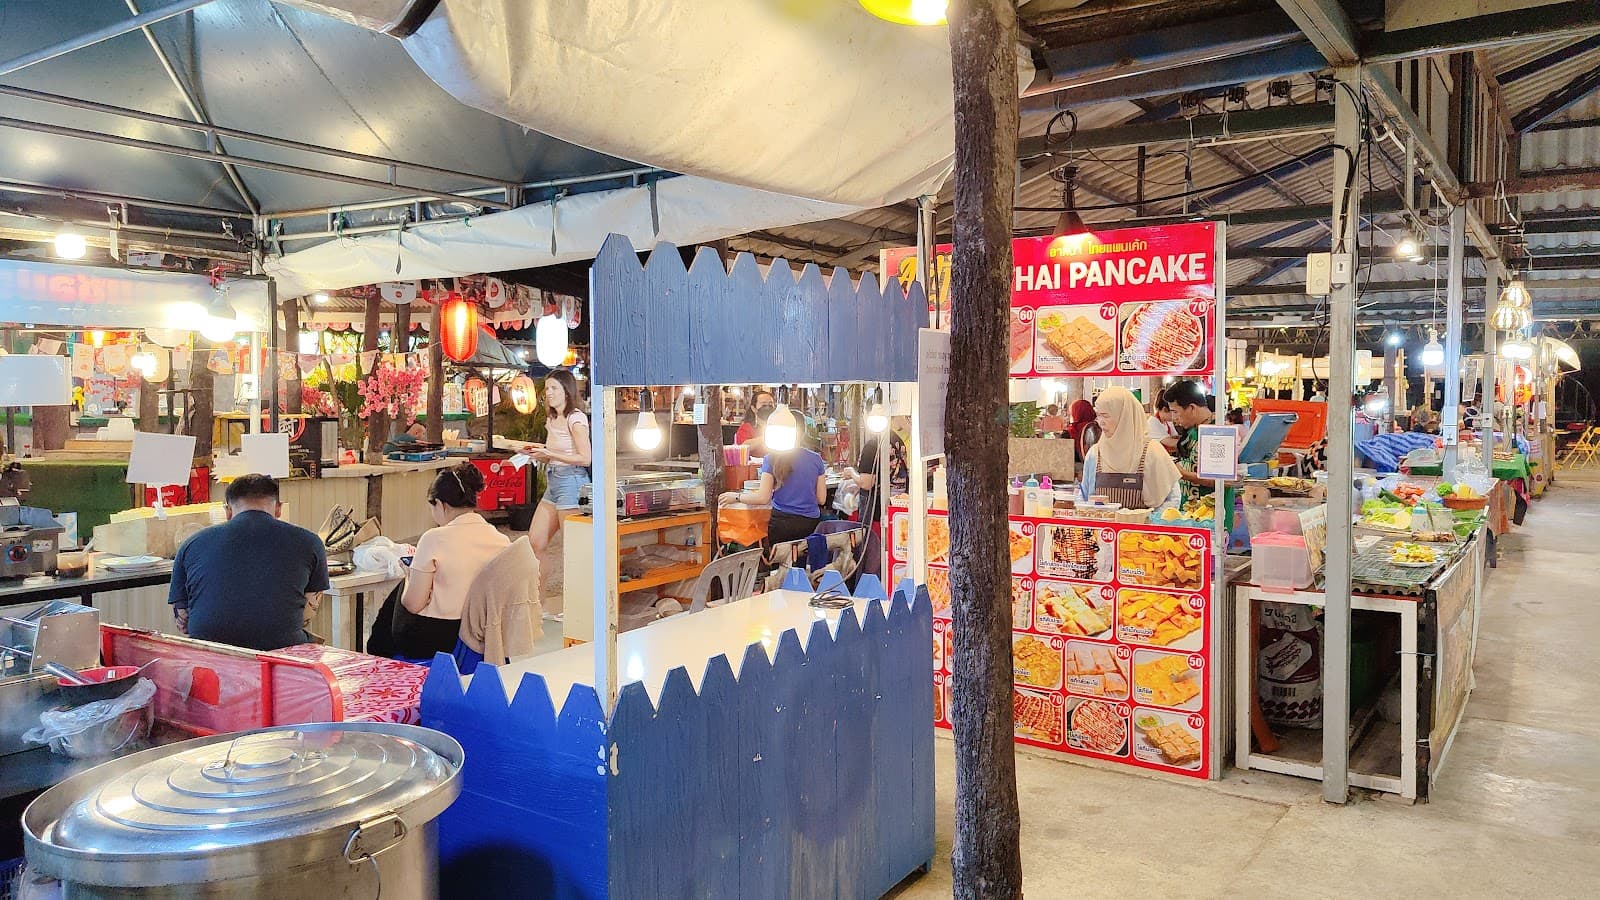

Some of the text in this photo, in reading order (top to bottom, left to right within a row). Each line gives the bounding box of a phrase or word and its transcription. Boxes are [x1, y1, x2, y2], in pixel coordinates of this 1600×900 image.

[1013, 252, 1206, 292] HAI PANCAKE
[1101, 306, 1115, 317] 70
[1191, 301, 1206, 313] 70
[1019, 309, 1033, 322] 60
[1022, 525, 1034, 535] 40
[1102, 531, 1114, 541] 50
[1191, 538, 1204, 548] 40
[1022, 580, 1032, 590] 40
[1101, 588, 1113, 598] 40
[1190, 598, 1204, 608] 40
[933, 623, 944, 633] 40
[1050, 639, 1063, 649] 40
[1117, 647, 1129, 658] 50
[1189, 657, 1202, 667] 50
[1051, 694, 1062, 705] 70
[1118, 706, 1129, 716] 70
[1189, 716, 1202, 727] 70
